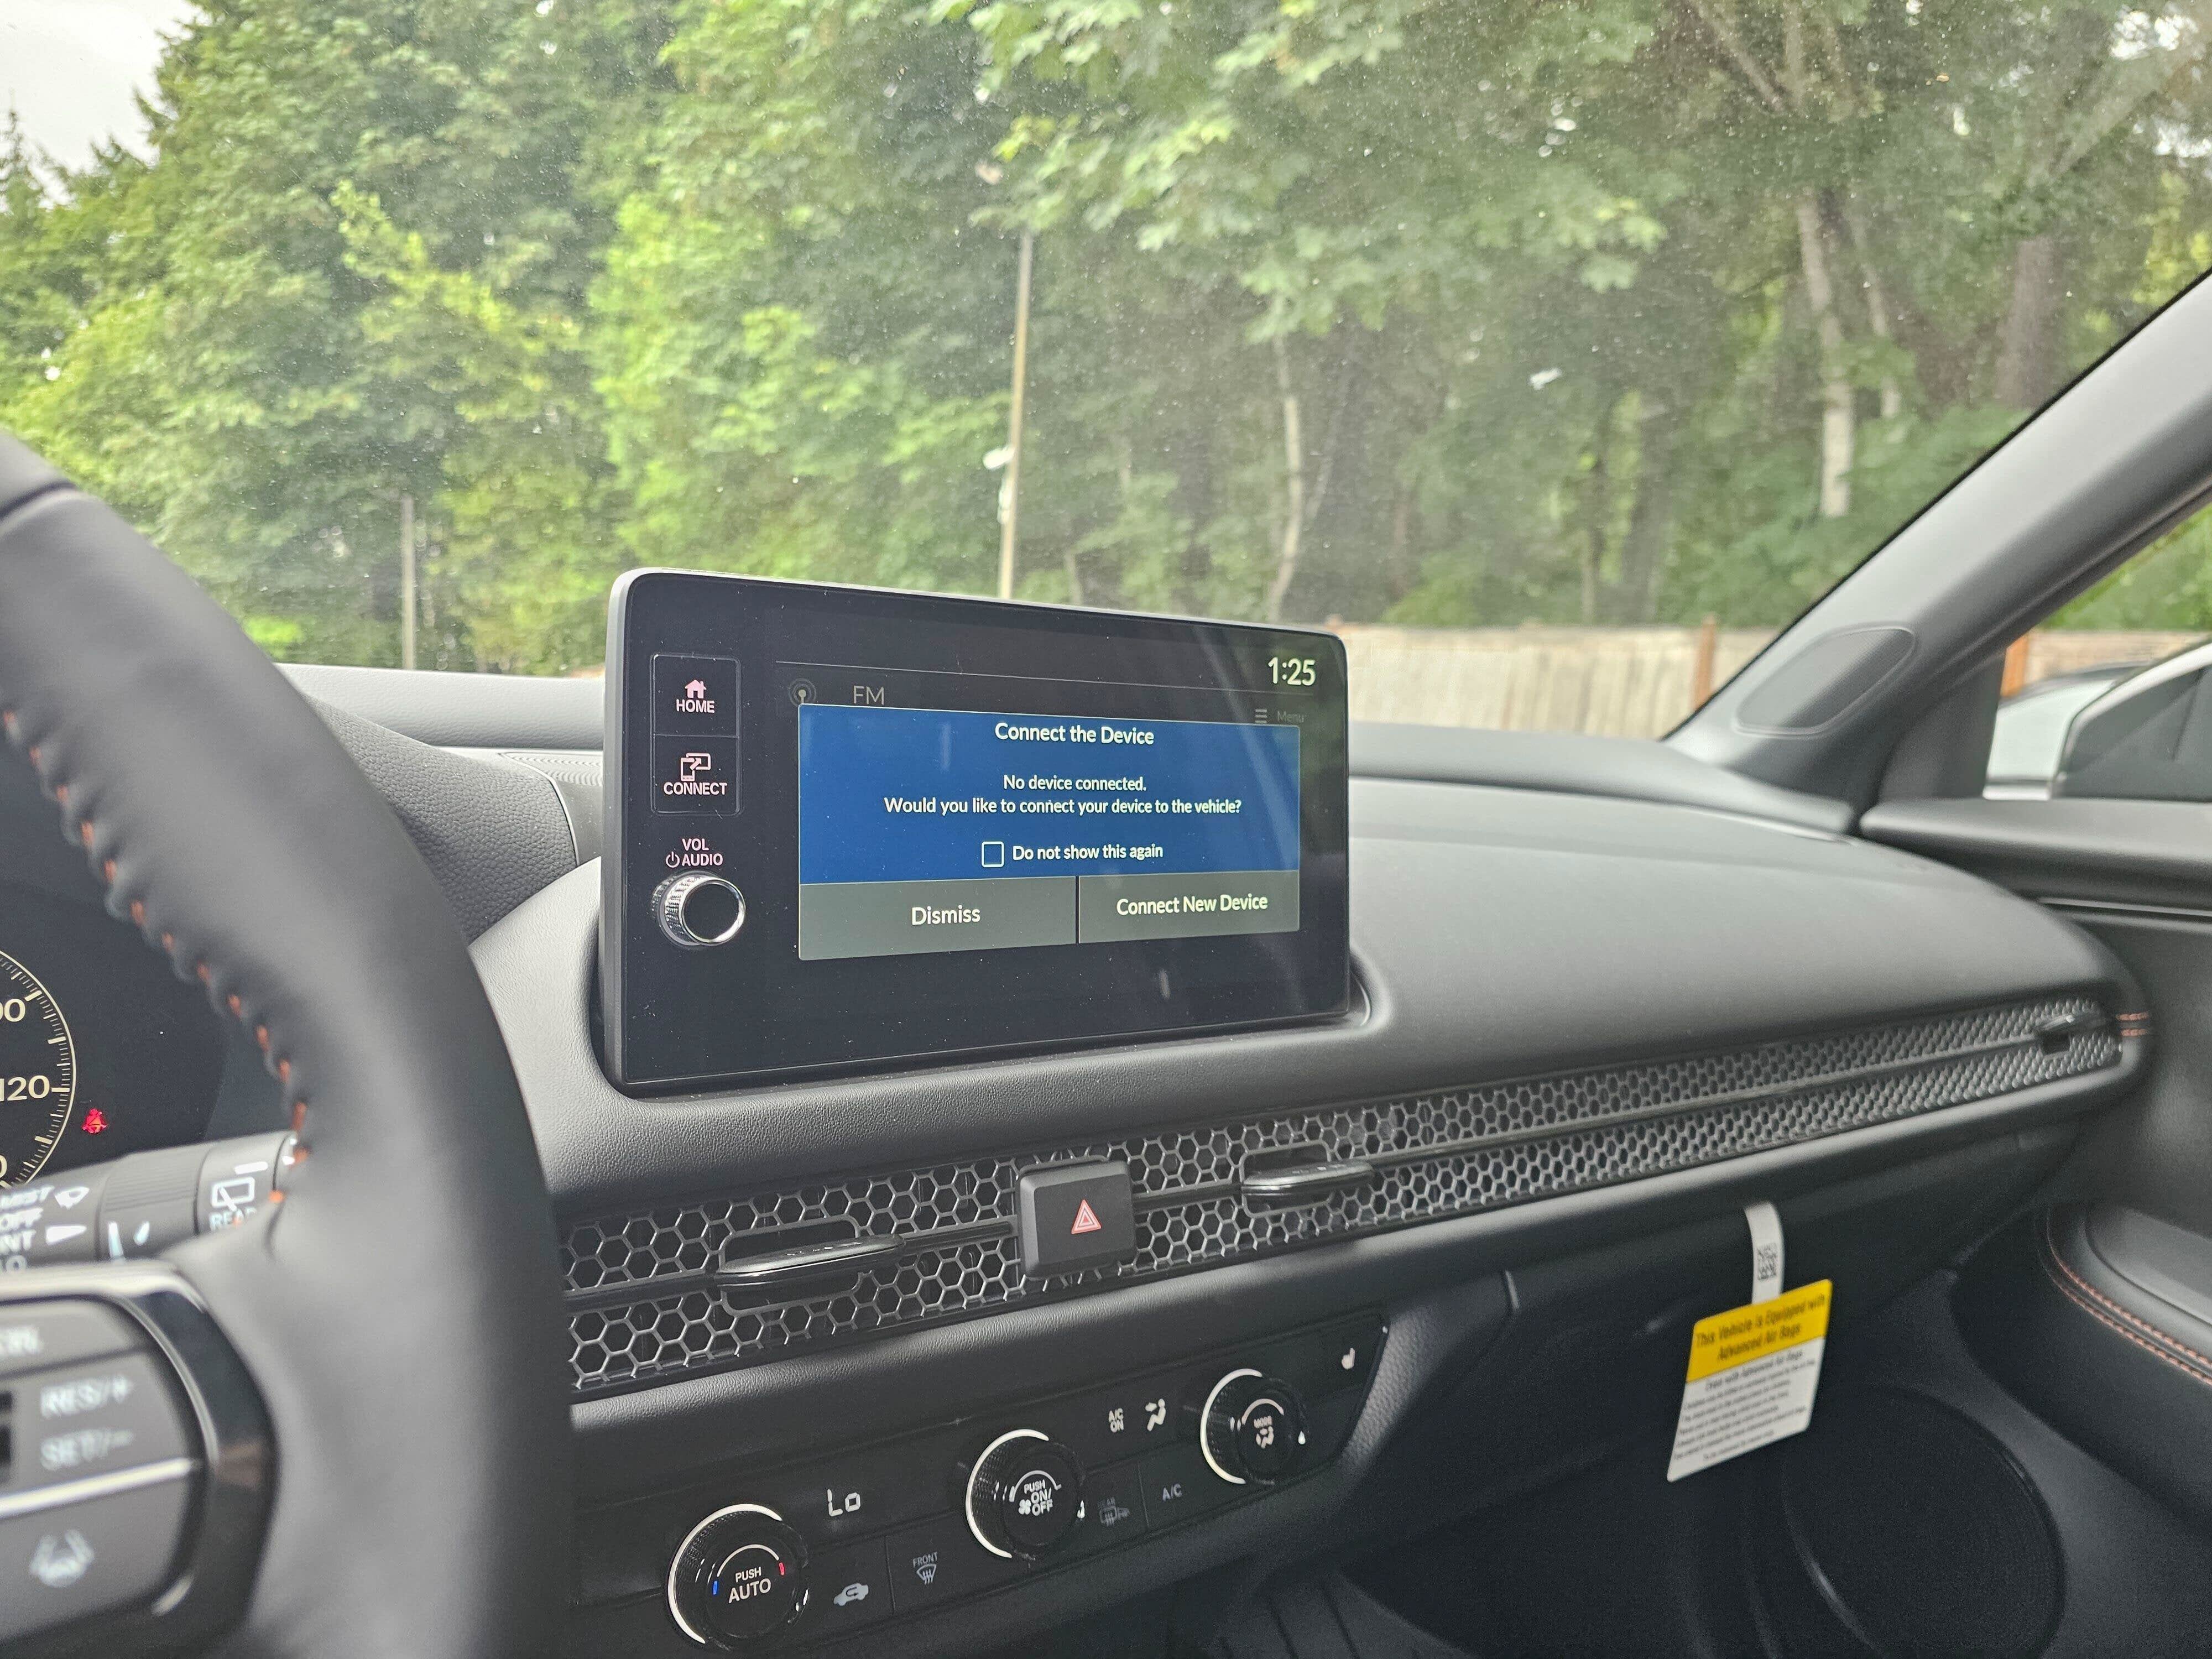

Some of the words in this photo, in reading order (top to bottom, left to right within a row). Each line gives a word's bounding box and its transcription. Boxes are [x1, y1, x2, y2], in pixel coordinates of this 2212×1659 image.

[1268, 657, 1316, 686] 1:25
[853, 685, 885, 705] FM
[676, 699, 715, 713] HOME
[995, 722, 1066, 742] Connect
[1070, 725, 1097, 743] the
[1100, 726, 1154, 745] Device
[664, 782, 727, 796] CONNECT
[1003, 774, 1025, 790] No
[1028, 775, 1073, 790] device
[1075, 776, 1147, 791] connected.
[884, 797, 936, 813] Would
[940, 800, 968, 816] you
[972, 797, 997, 813] like
[1000, 799, 1016, 813] to
[1019, 800, 1075, 814] connect
[1078, 801, 1108, 816] your
[1111, 799, 1152, 813] device
[1155, 800, 1169, 813] to
[1171, 799, 1192, 813] the
[1194, 799, 1242, 813] vehicle?
[682, 838, 709, 851] VOL
[1013, 845, 1034, 860] Do
[1037, 846, 1061, 859] not
[1063, 844, 1100, 859] show
[1102, 844, 1126, 858] this
[1129, 843, 1164, 860] again
[681, 854, 723, 867] AUDIO
[1117, 897, 1180, 915] Connect
[1183, 895, 1217, 912] New
[1220, 893, 1269, 911] Device
[911, 905, 980, 925] Dismiss
[1697, 1332, 1715, 1348] This
[1719, 1319, 1752, 1340] Vehicle
[1755, 1314, 1763, 1327] is
[1765, 1302, 1806, 1325] Equipped
[1808, 1293, 1825, 1310] with
[1718, 1332, 1762, 1361] Advanced
[1780, 1323, 1801, 1339] Bags
[1024, 1479, 1046, 1494] PUSH
[1162, 1484, 1182, 1501] A/C
[1031, 1488, 1051, 1504] ON/
[1032, 1499, 1053, 1516] OFF
[912, 1552, 938, 1568] FRONT
[735, 1567, 761, 1583] PUSH
[728, 1578, 771, 1603] AUTO
